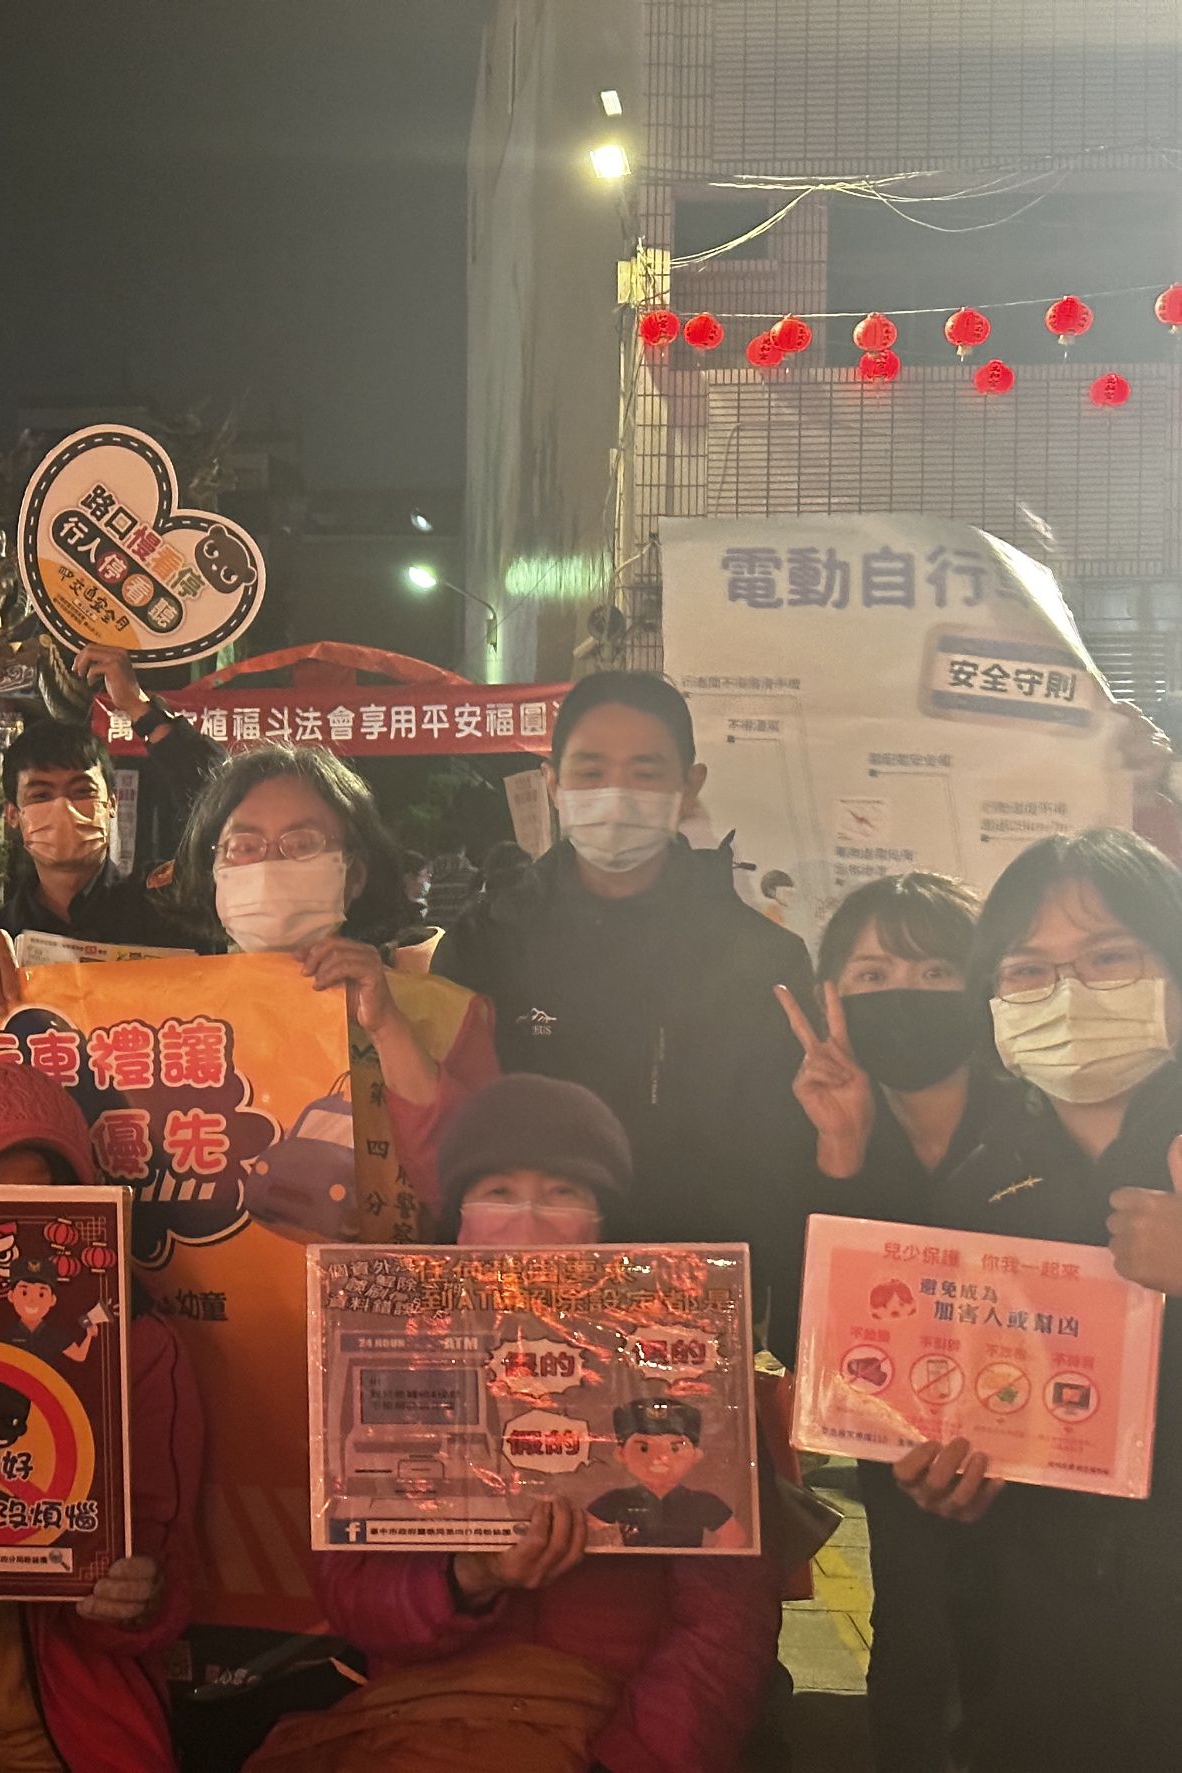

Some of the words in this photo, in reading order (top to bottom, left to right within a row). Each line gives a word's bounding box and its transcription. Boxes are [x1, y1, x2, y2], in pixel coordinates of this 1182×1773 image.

[80, 484, 206, 599] 路口慢看停
[60, 516, 179, 628] 行人停看聽
[722, 546, 1031, 610] 電動自行
[949, 659, 1077, 703] 安全守則
[95, 1110, 229, 1178] 優先
[884, 1242, 961, 1268] 兒少保護
[981, 1253, 1081, 1280] 你我一起來
[920, 1278, 999, 1304] 避免成為
[443, 1337, 479, 1350] ATM
[504, 1351, 576, 1378] 假的
[506, 1428, 580, 1457] 假的
